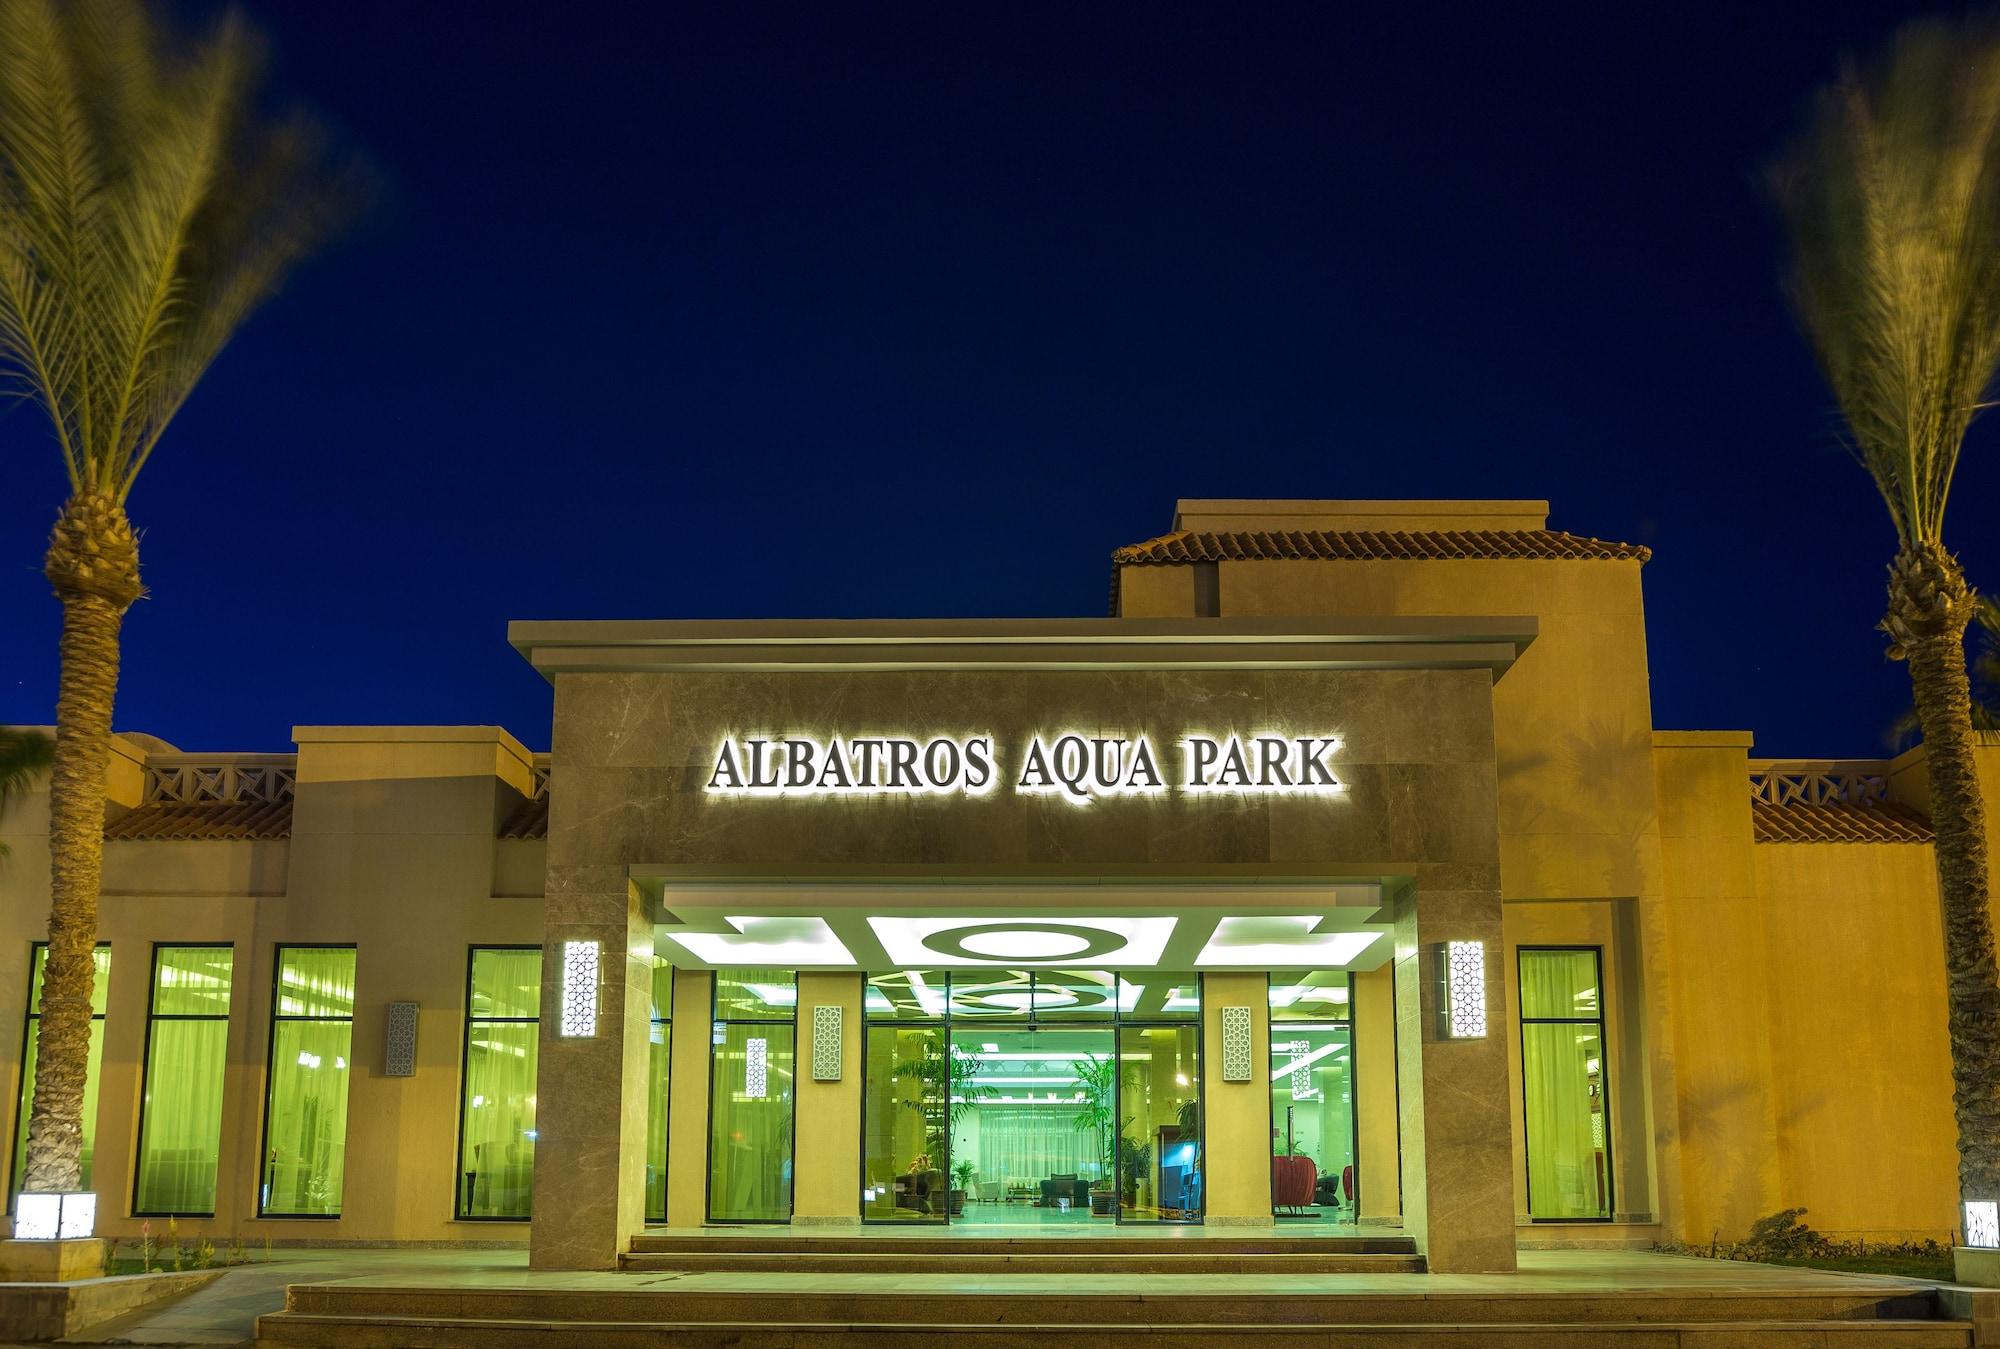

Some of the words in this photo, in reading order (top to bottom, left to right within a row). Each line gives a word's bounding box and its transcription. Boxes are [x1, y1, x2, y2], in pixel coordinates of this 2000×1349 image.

[708, 738, 991, 788] ALBATROS
[1018, 736, 1162, 795] AQUA
[1188, 738, 1338, 786] PARK
